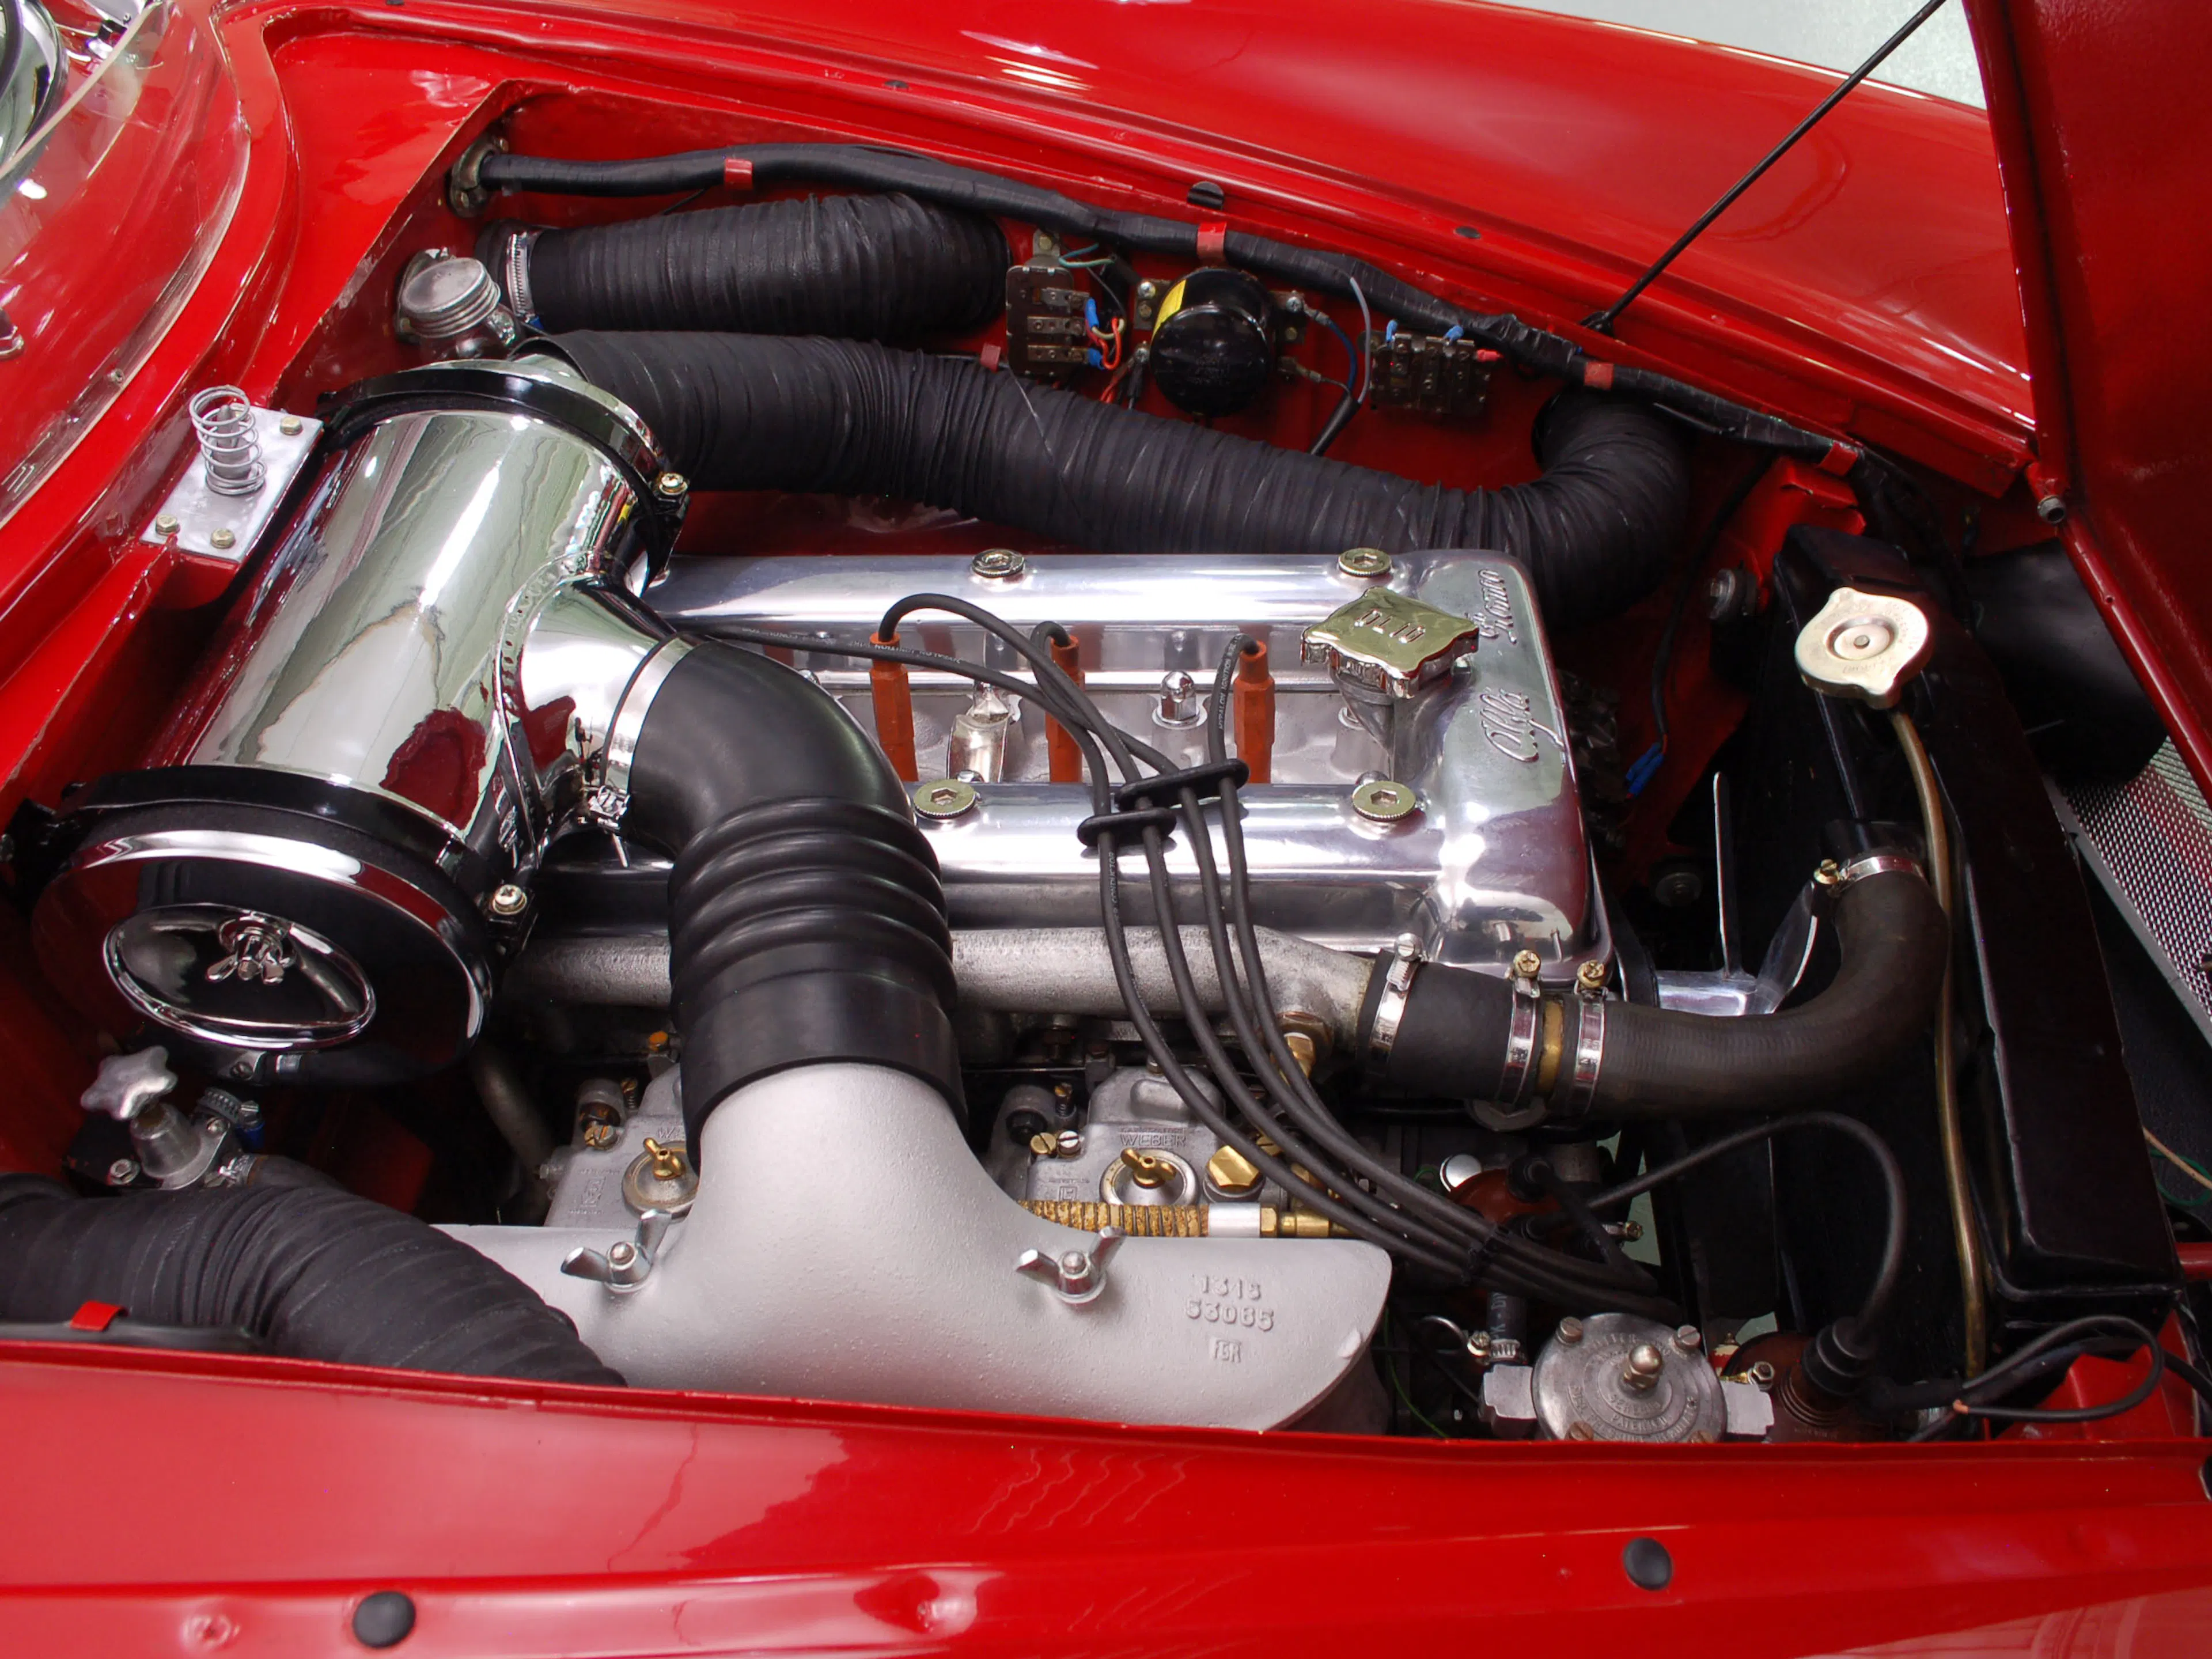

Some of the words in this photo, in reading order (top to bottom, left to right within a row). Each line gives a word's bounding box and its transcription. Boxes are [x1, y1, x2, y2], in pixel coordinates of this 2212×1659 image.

[1465, 569, 1517, 645] Romeo
[1354, 608, 1427, 644] OLIO
[1479, 687, 1565, 763] Alfa
[1108, 851, 1119, 903] CONDUCTOR
[1119, 1133, 1187, 1147] WEBER
[1200, 1275, 1262, 1301] 1315
[1185, 1298, 1275, 1332] 53065
